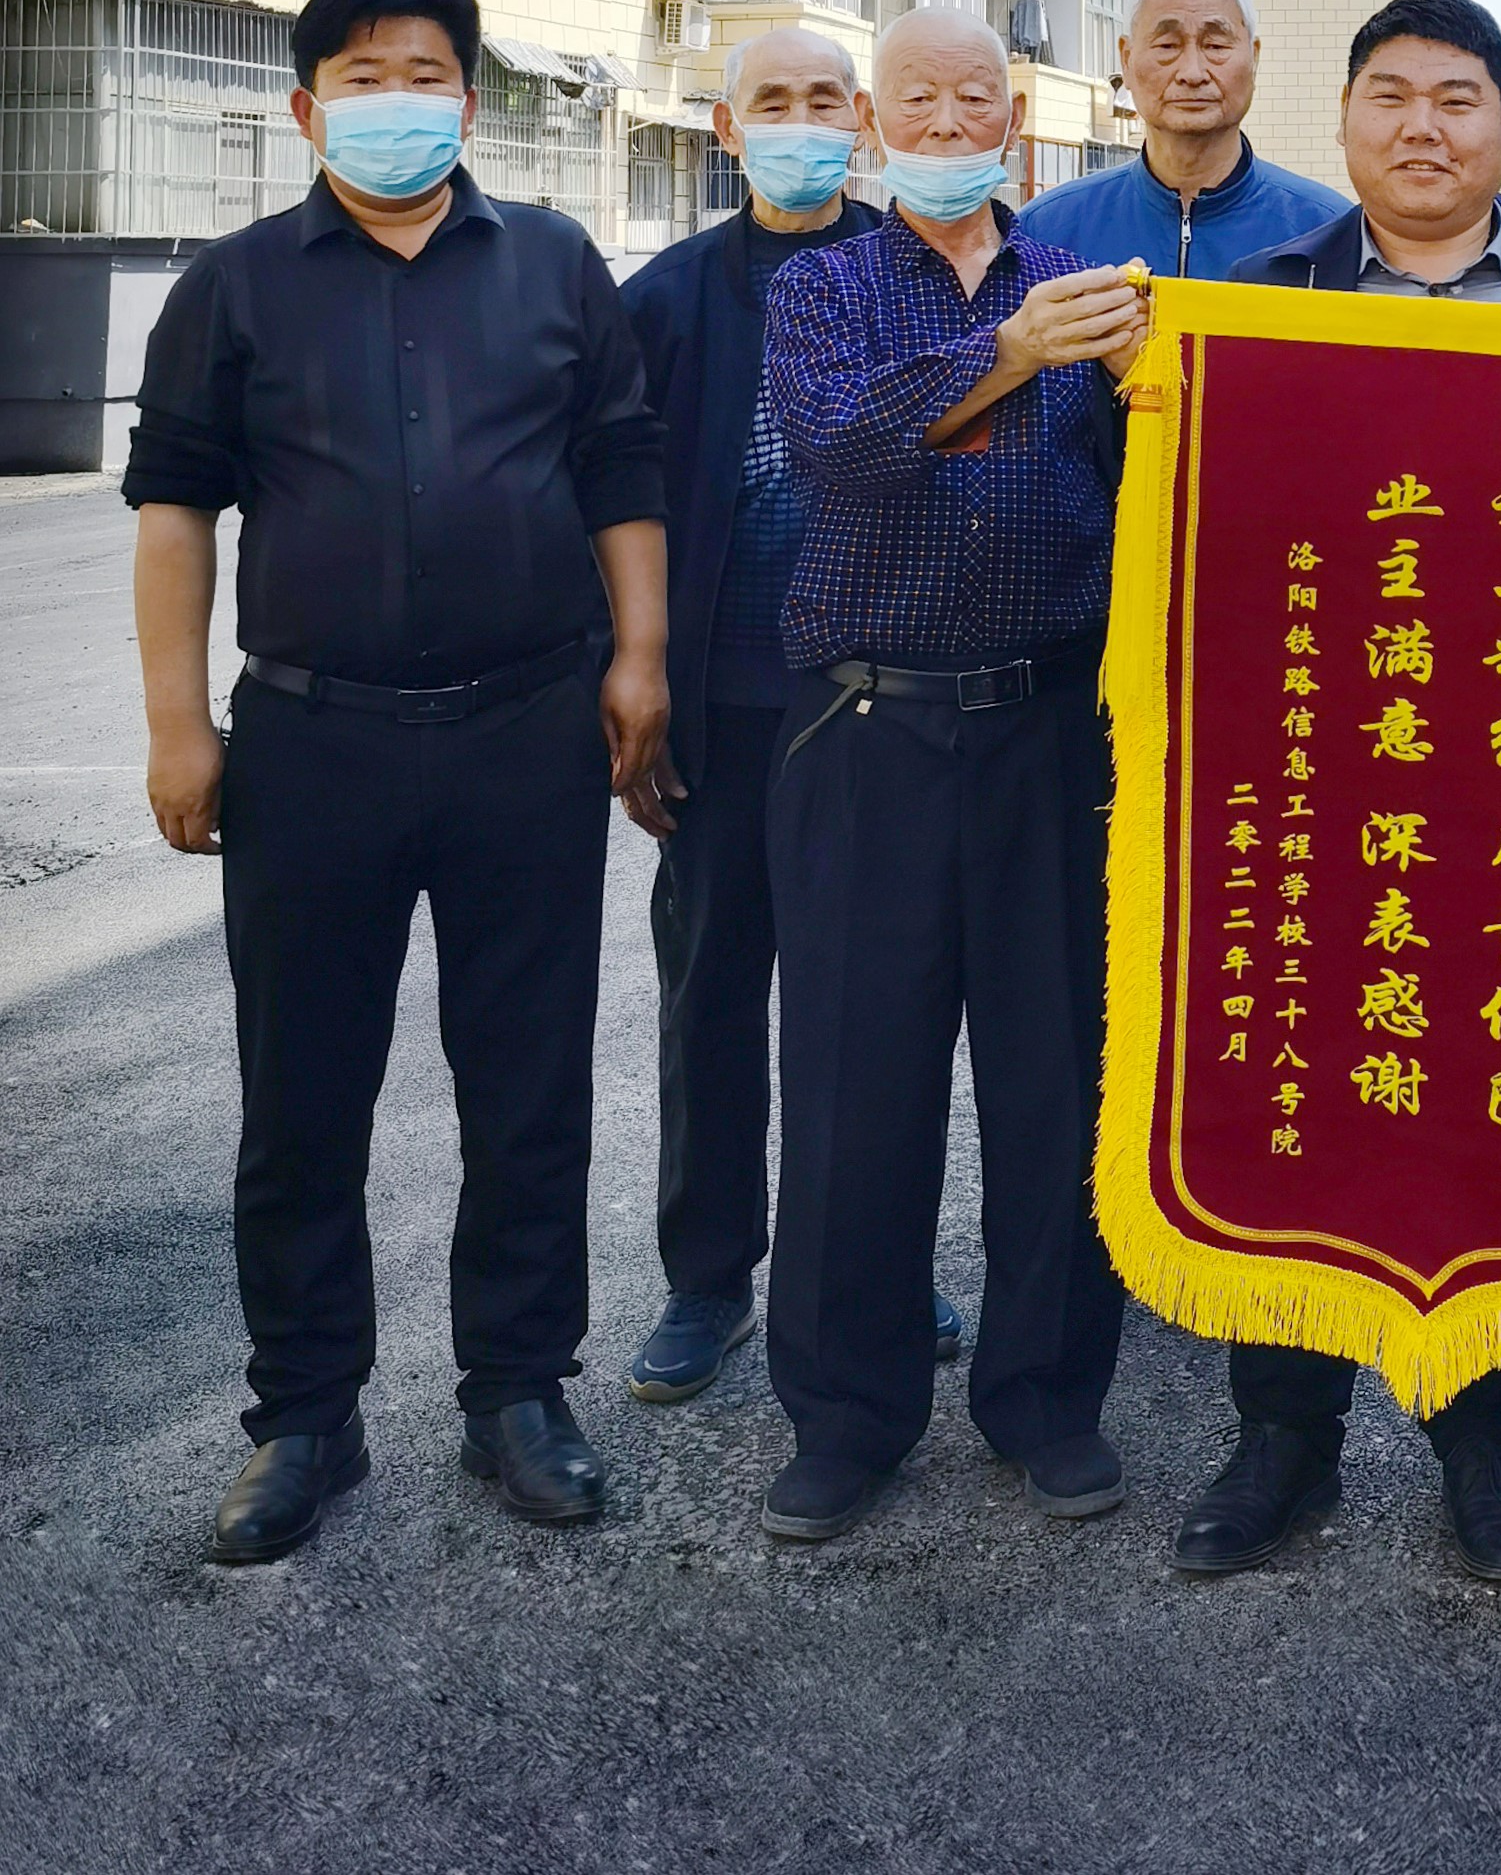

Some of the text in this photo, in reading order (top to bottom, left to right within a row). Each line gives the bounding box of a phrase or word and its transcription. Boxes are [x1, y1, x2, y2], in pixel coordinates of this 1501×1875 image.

[1218, 783, 1262, 1062] 二零二二年四月
[1270, 541, 1323, 1156] 洛阳铁路信息工程学校三十八号院
